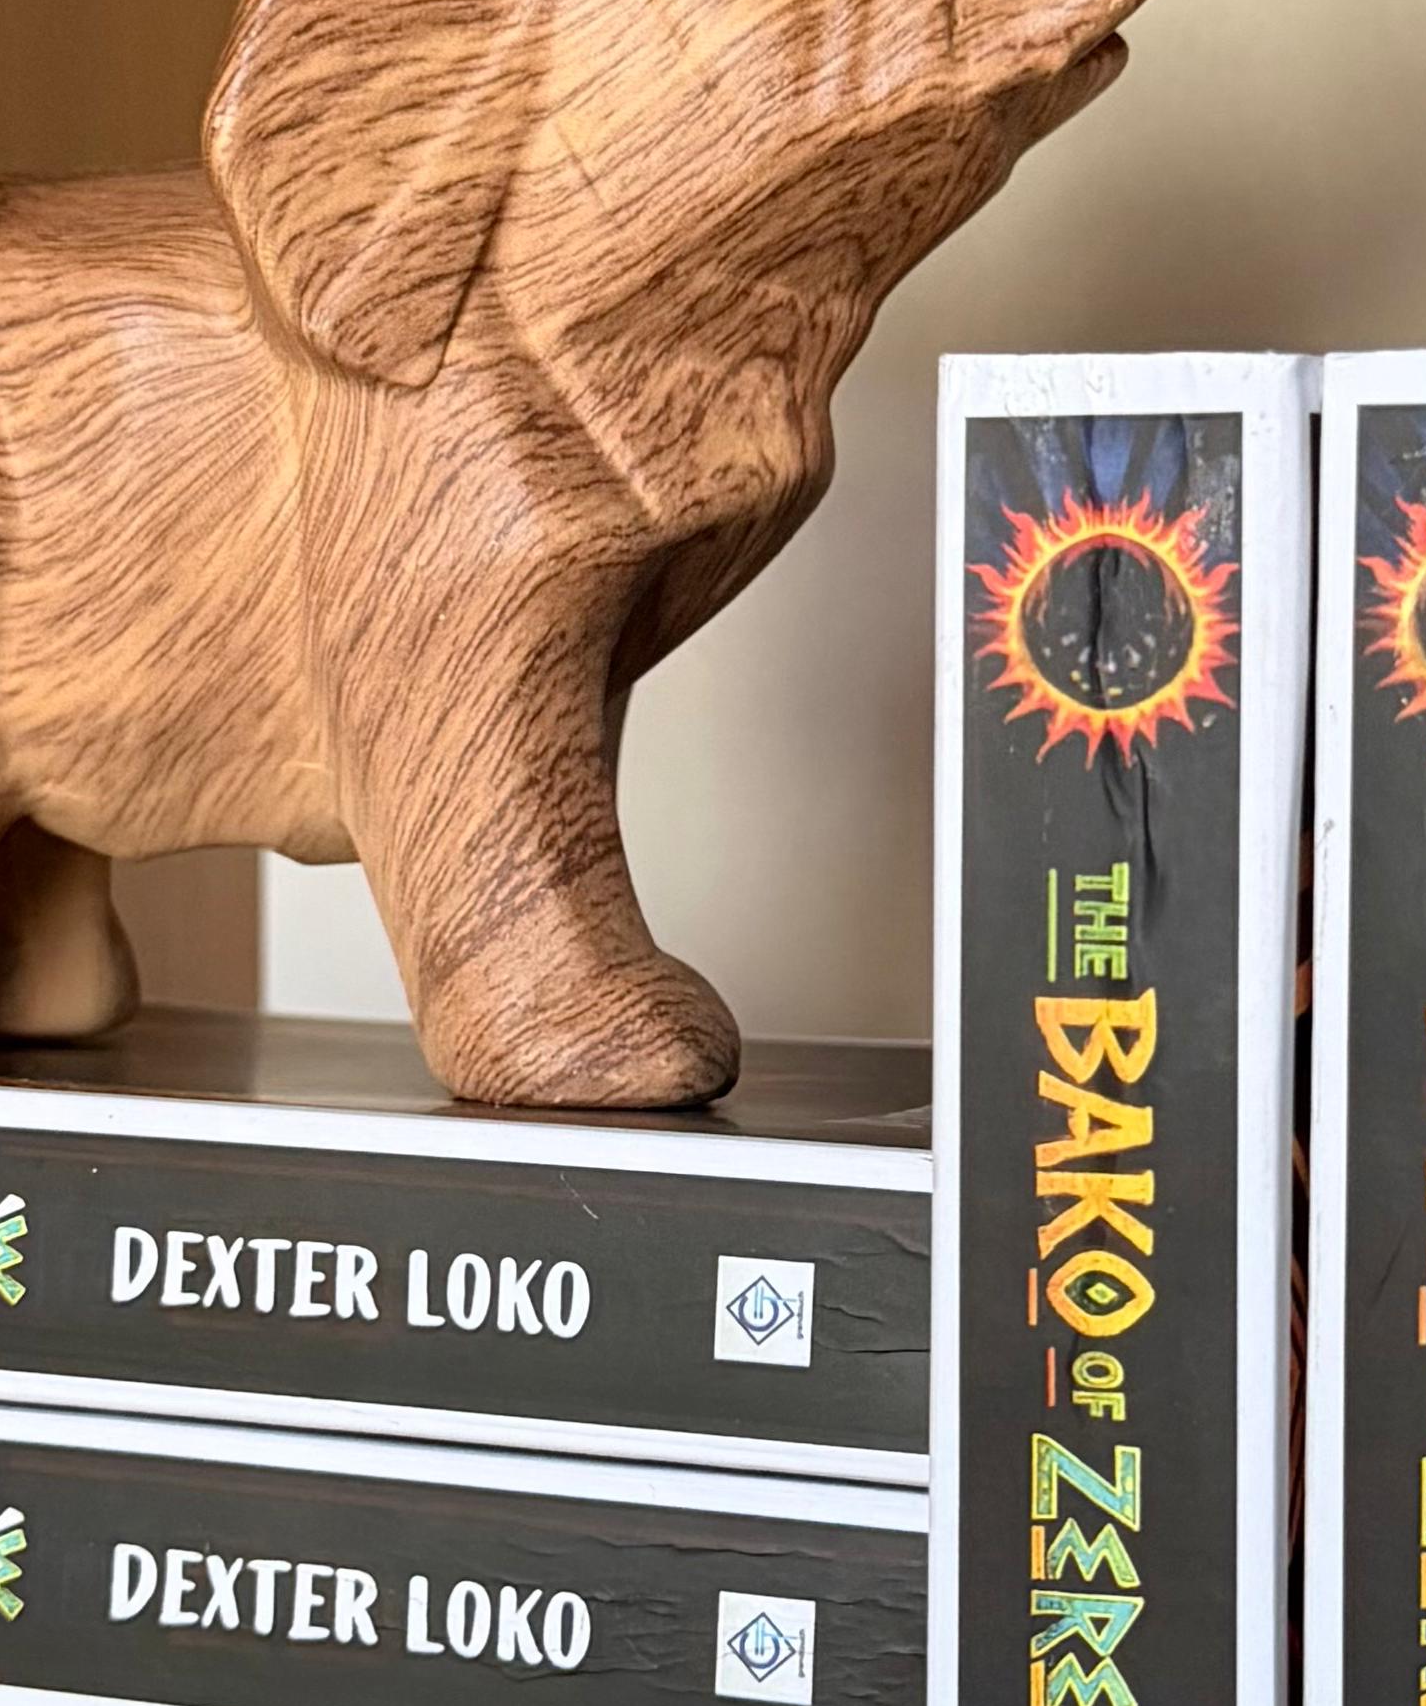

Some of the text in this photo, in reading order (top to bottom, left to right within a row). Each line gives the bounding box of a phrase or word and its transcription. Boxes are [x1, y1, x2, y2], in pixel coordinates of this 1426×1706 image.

[1073, 862, 1130, 979] THE
[1034, 987, 1158, 1337] BAKO
[111, 1227, 590, 1338] DEXTER LOKO
[1072, 1351, 1126, 1421] OF
[109, 1543, 591, 1669] DEXTER LOKO
